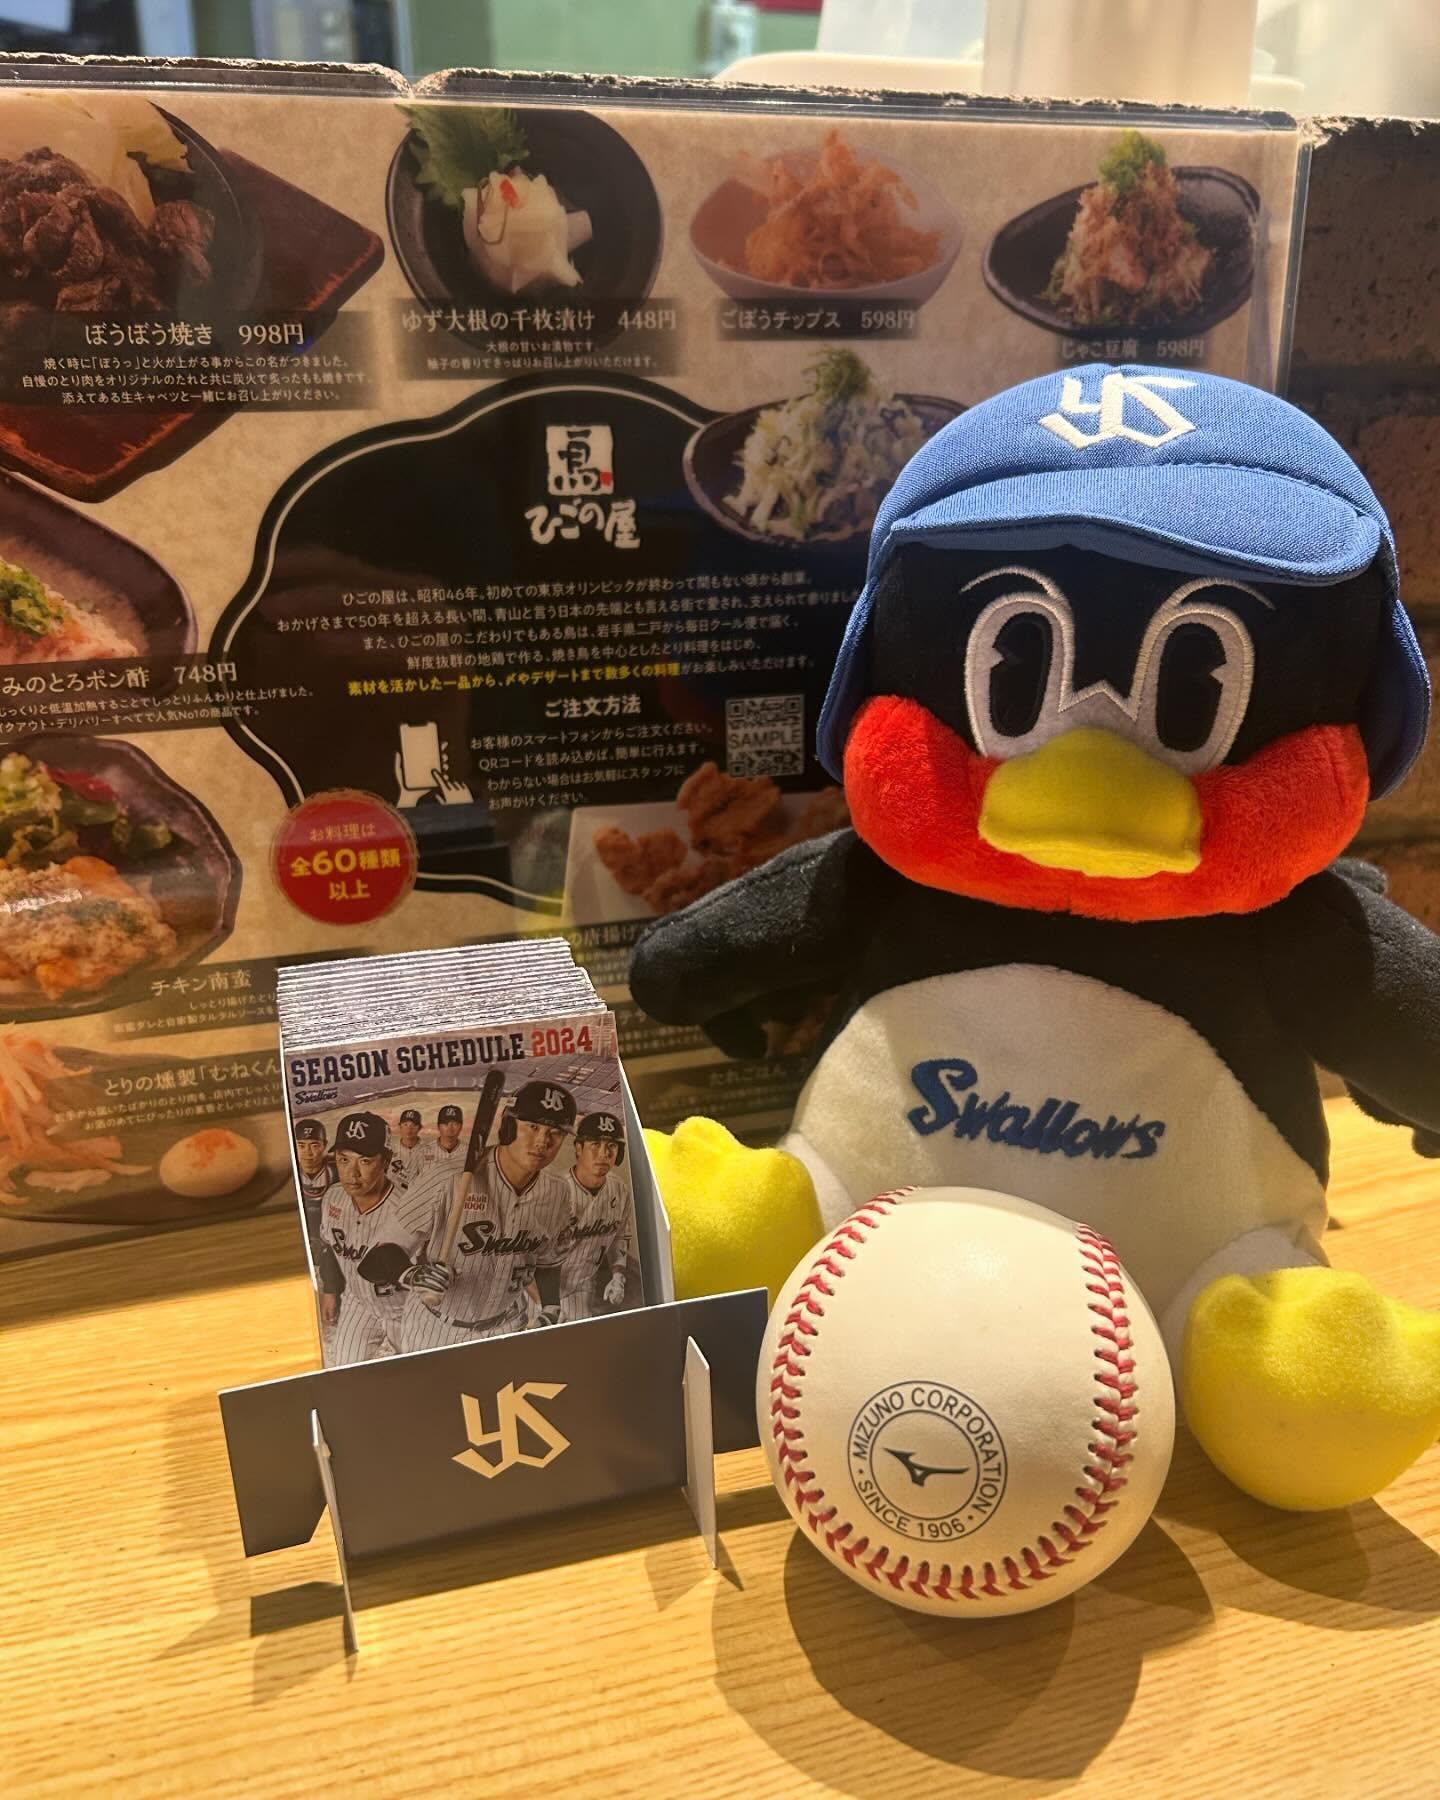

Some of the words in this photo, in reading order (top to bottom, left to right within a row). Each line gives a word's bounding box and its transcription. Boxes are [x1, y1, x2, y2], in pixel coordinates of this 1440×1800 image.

[402, 308, 595, 332] ゆず大根の千枚漬け
[618, 309, 677, 331] 448円
[721, 310, 841, 331] ごぼうチップス
[861, 309, 917, 330] 598円
[85, 322, 213, 347] ぼうぼう焼き
[238, 322, 304, 346] 998円
[1061, 338, 1138, 359] じゃこ豆腐
[1157, 338, 1205, 359] 598円
[524, 498, 641, 549] ひごの屋
[0, 666, 151, 697] みのとろポン酢
[174, 662, 237, 685] 748円
[544, 694, 641, 719] ご注文方法
[729, 730, 801, 749] SAMPLE
[309, 823, 376, 843] お料理は
[289, 848, 400, 878] 全60種類
[328, 878, 371, 901] 以上
[150, 969, 252, 997] チキン南蛮
[290, 1048, 391, 1088] SEASON
[396, 1032, 525, 1074] SCHEDULE
[530, 1025, 593, 1057] 2024
[906, 1057, 1166, 1160] Swallows
[852, 1390, 905, 1460] MIZUNO
[911, 1387, 1002, 1515] CORPORATION
[858, 1479, 908, 1532] SINCE
[917, 1518, 966, 1539] 1906
